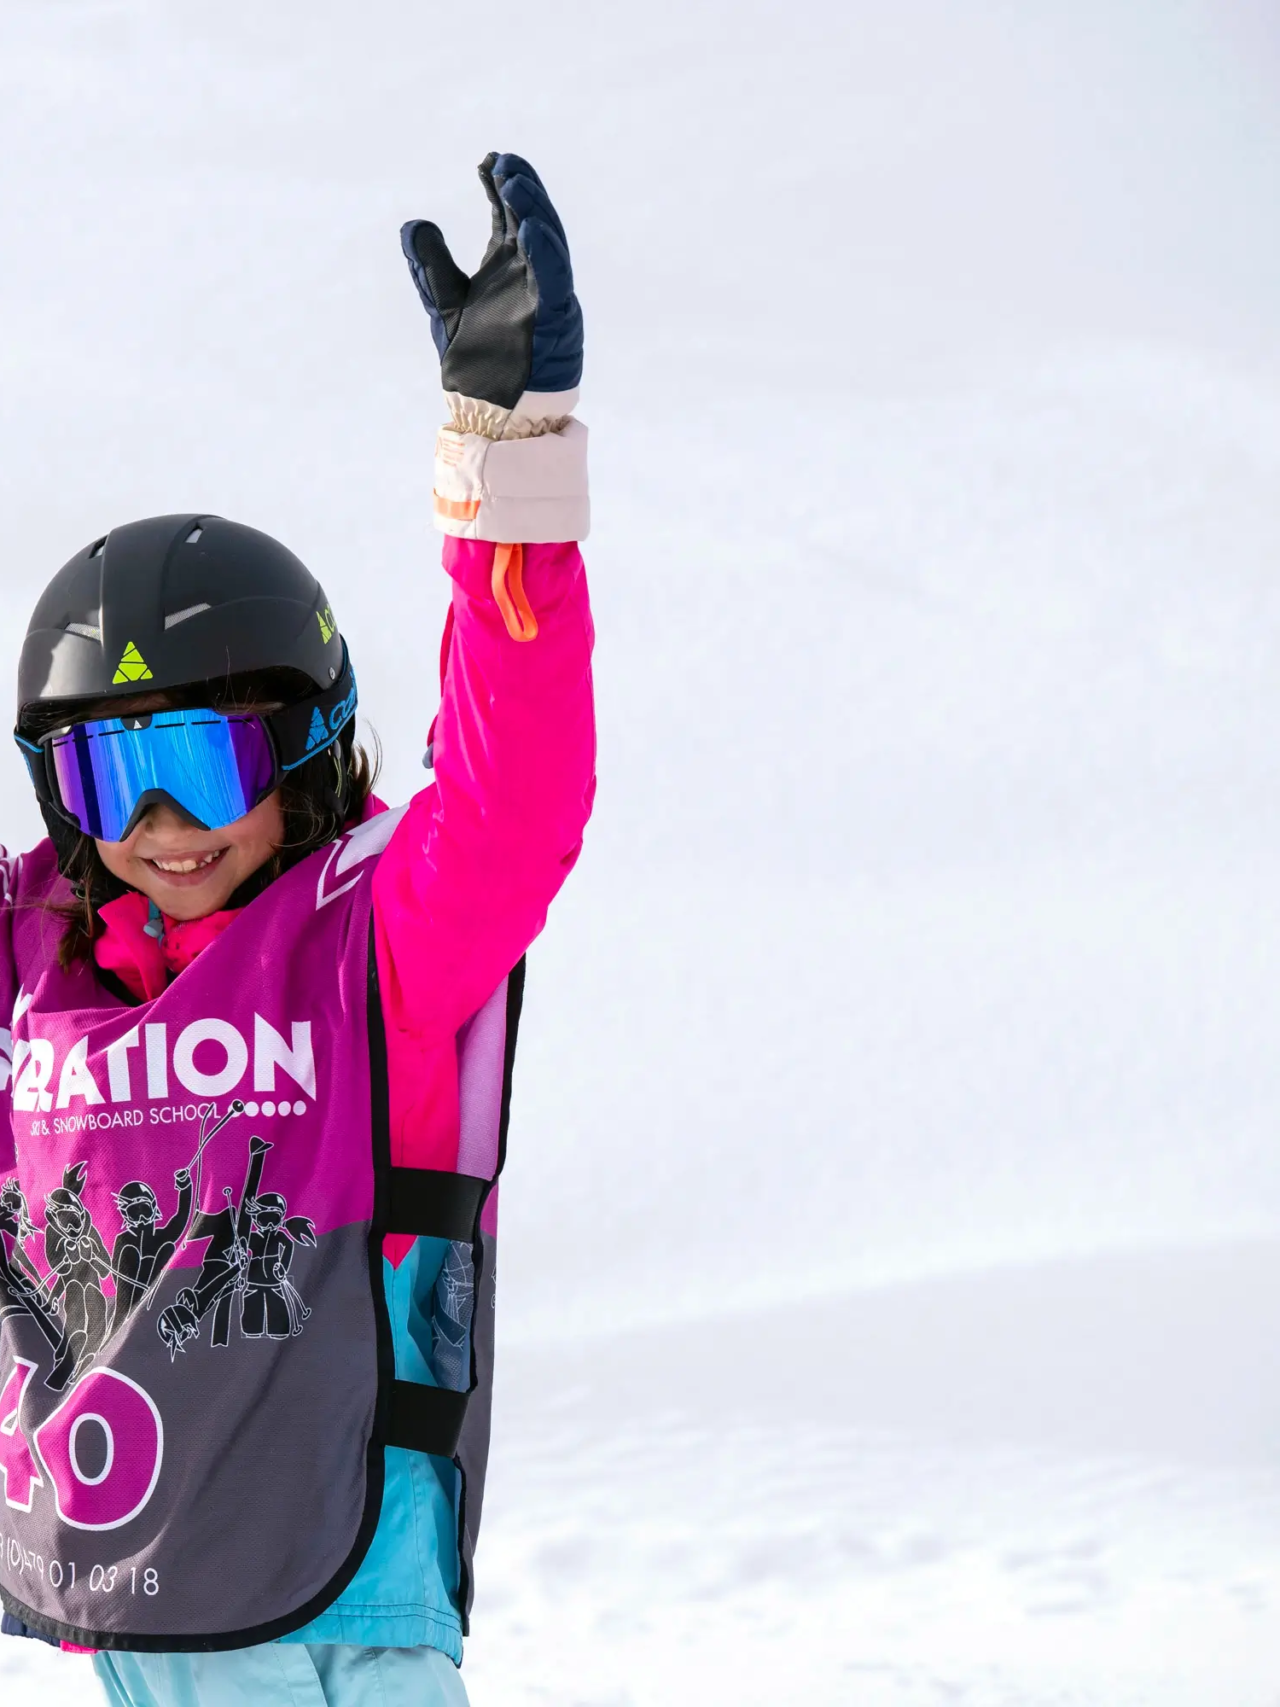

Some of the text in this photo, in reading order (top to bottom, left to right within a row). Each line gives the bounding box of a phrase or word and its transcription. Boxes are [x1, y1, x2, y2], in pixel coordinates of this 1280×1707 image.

[41, 1119, 51, 1136] &
[53, 1108, 144, 1135] SNOWBOARD
[150, 1103, 222, 1125] SCHOOL
[49, 1560, 76, 1589] 01
[89, 1564, 118, 1593] 03
[130, 1566, 160, 1596] 18
